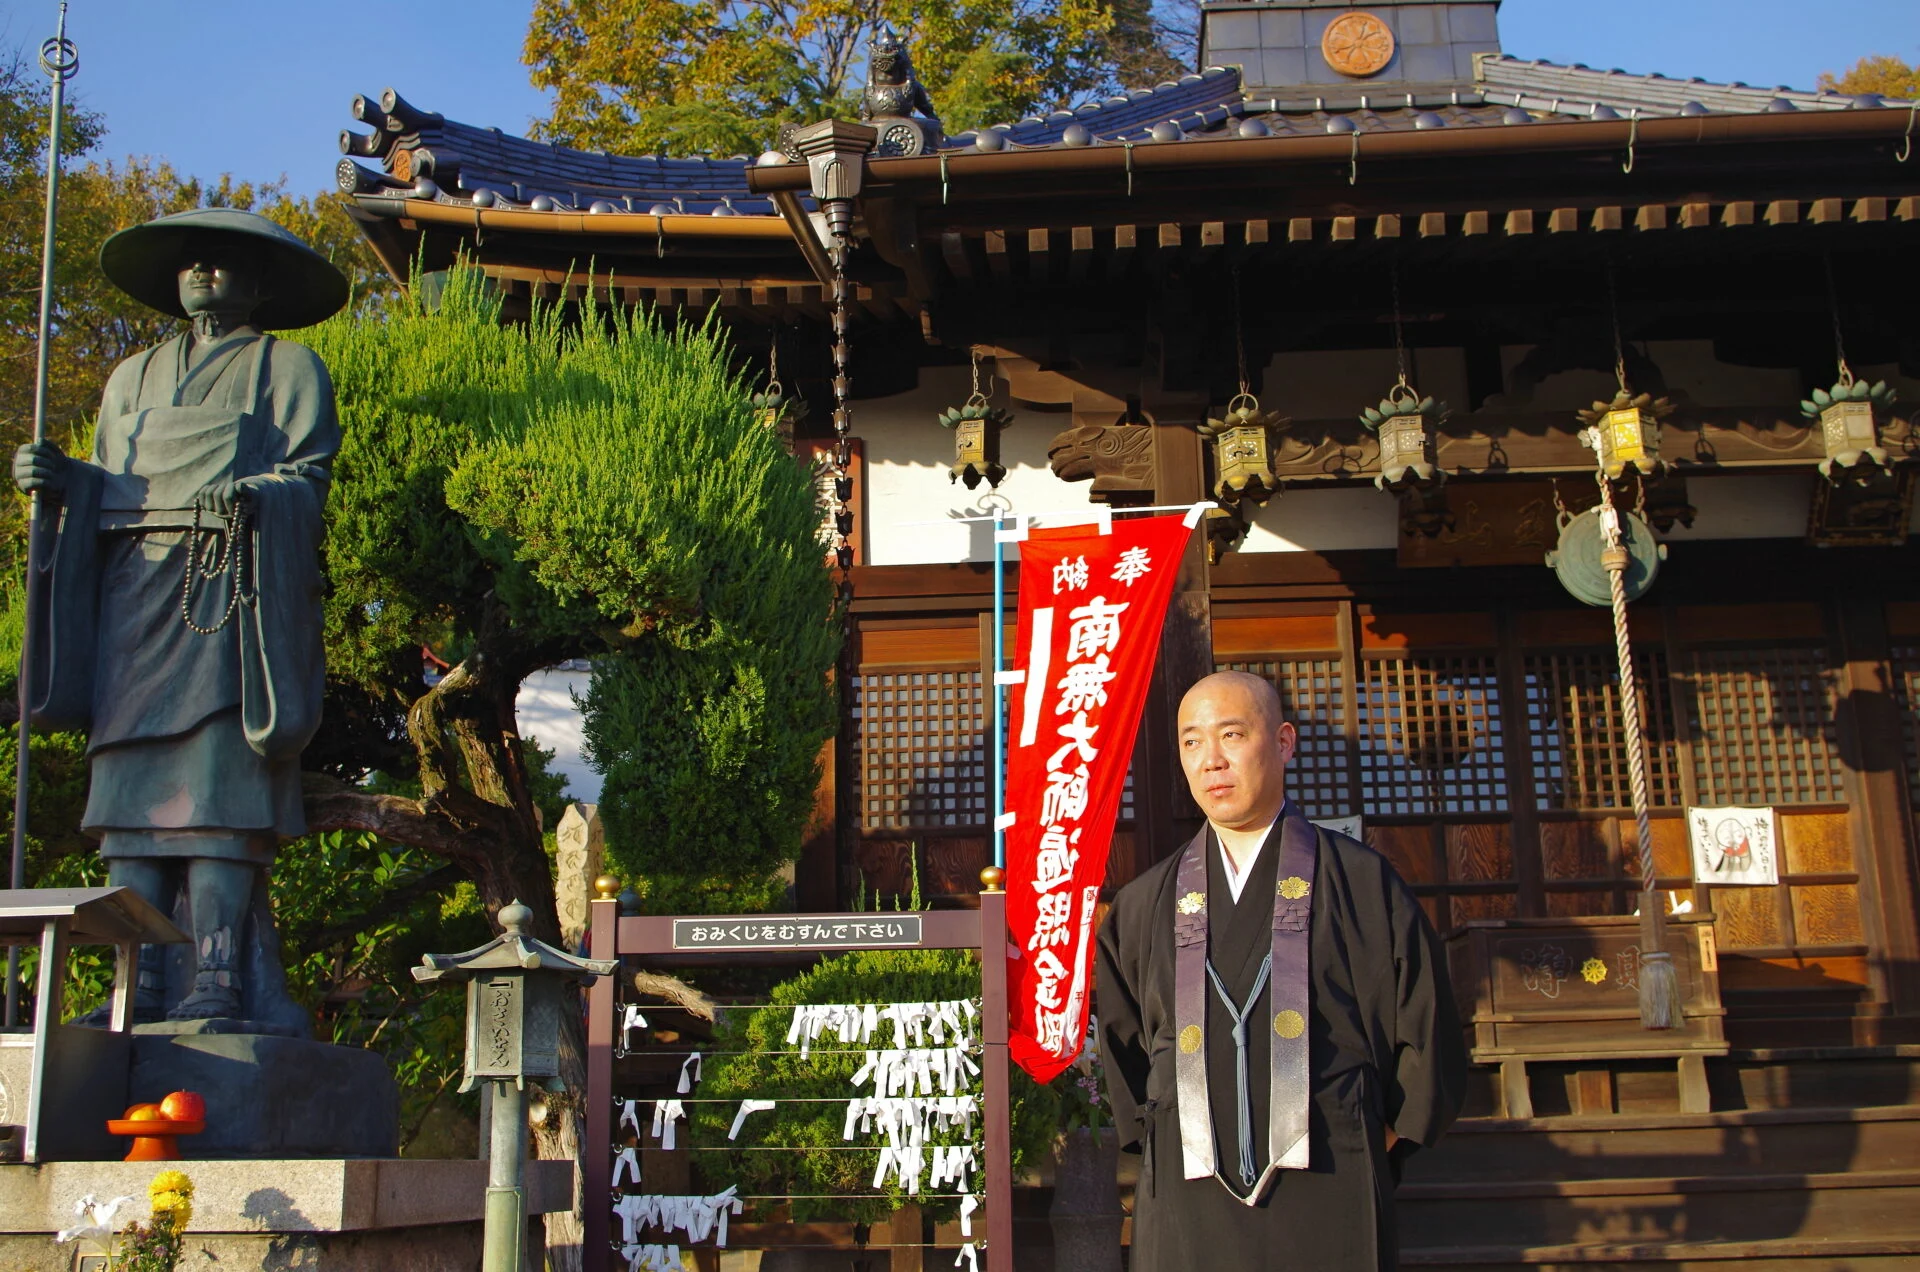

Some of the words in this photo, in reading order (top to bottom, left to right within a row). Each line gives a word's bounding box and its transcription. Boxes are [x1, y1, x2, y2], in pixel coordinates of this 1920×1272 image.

[691, 922, 904, 942] おみくじをむすんで下さい
